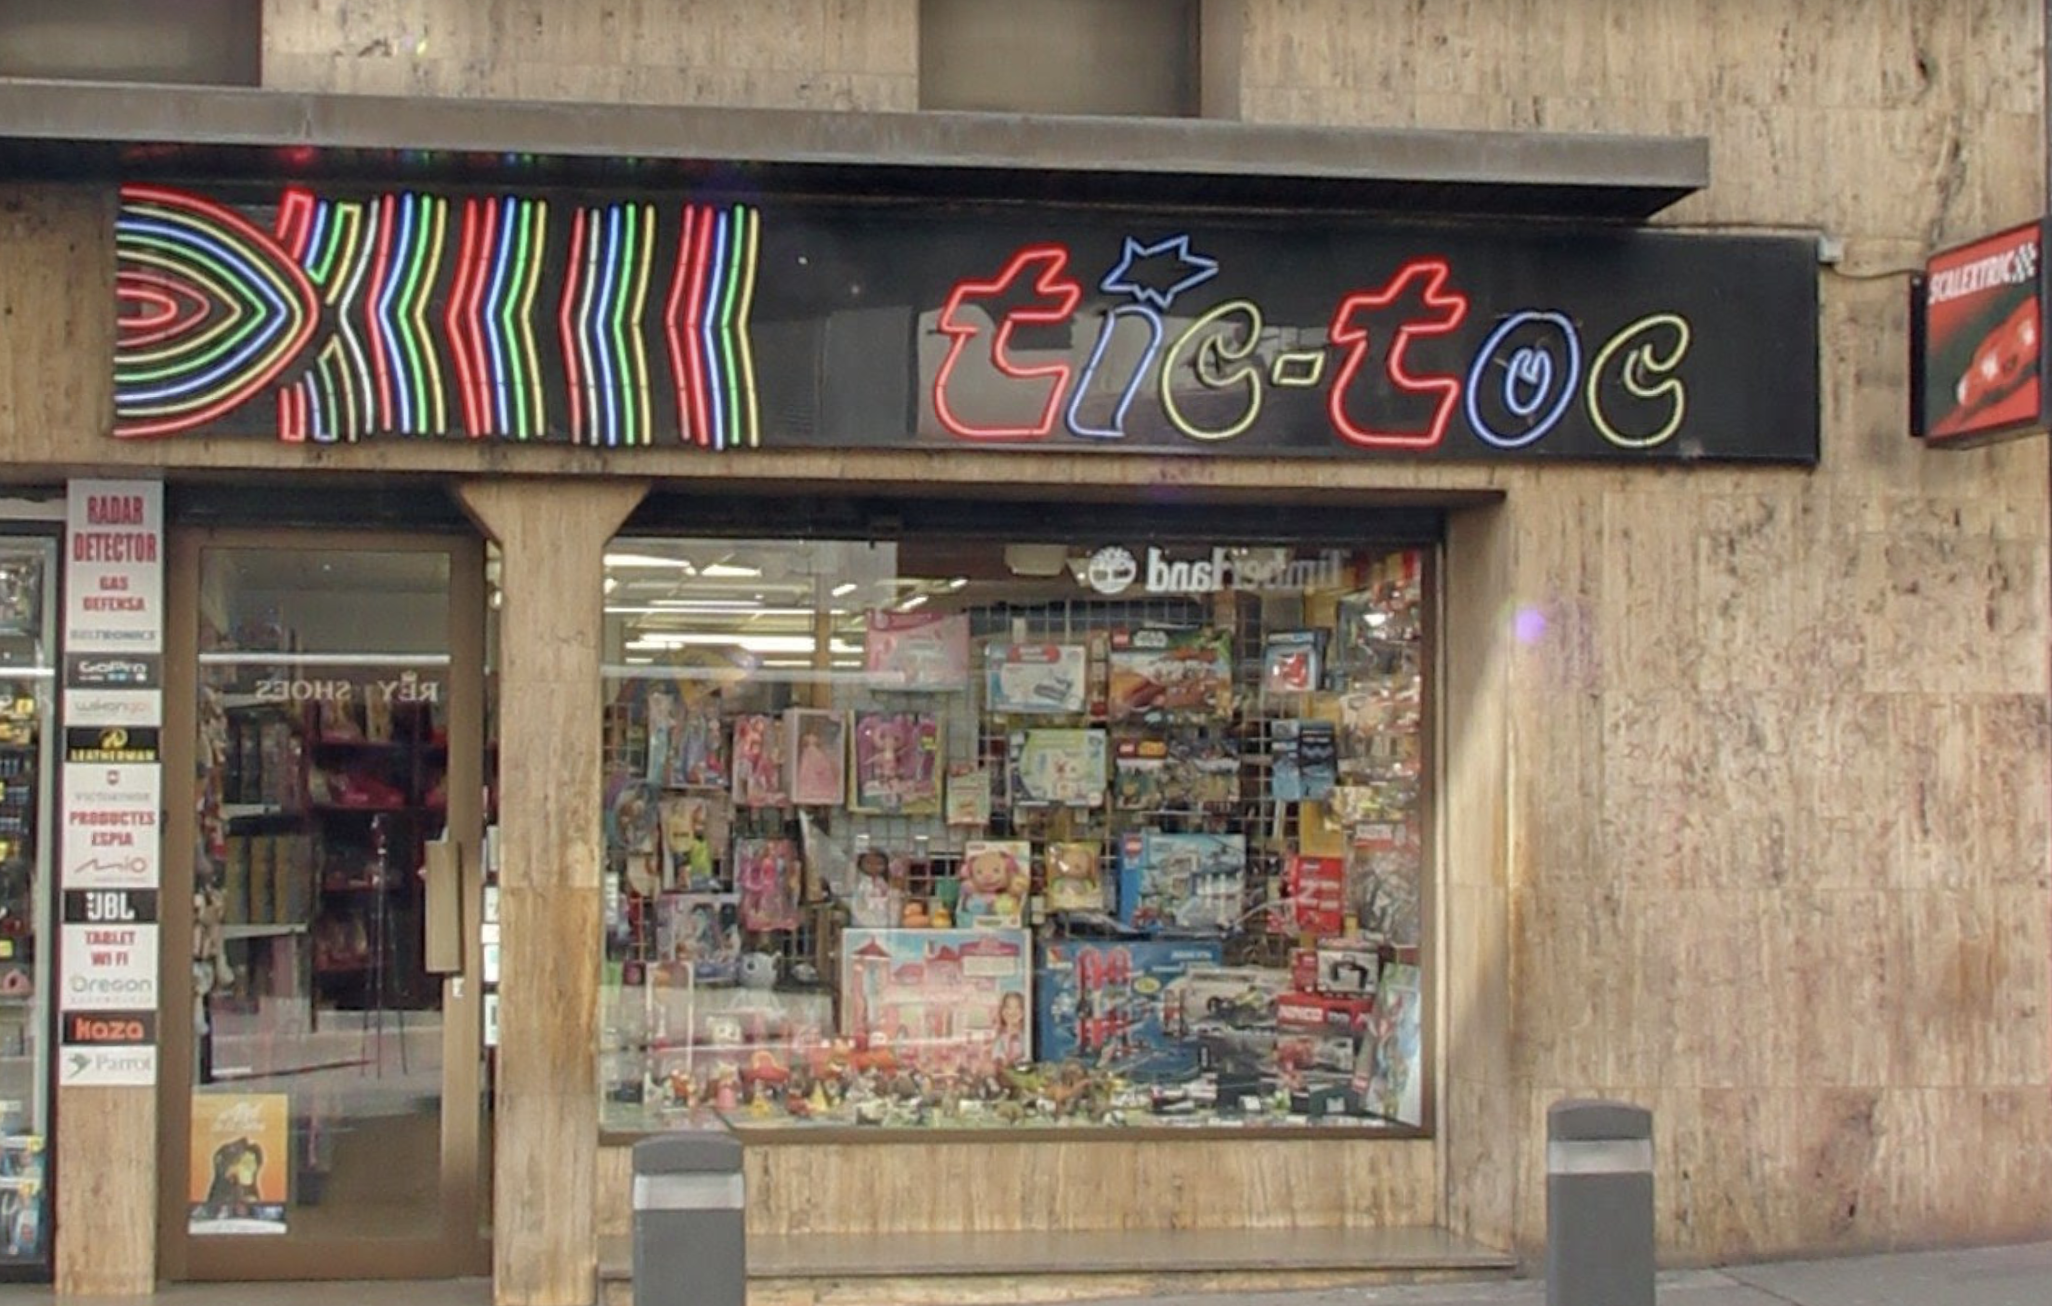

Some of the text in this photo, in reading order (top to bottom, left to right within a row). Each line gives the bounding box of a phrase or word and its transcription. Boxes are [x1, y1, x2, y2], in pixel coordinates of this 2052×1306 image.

[932, 235, 1691, 449] tic-toc
[86, 495, 144, 525] RADAR
[73, 532, 157, 562] DETECTOR
[99, 575, 129, 591] GAS
[83, 596, 145, 612] DEFENSA
[69, 811, 155, 826] PRODUCTES
[91, 832, 134, 847] ESPIA
[86, 891, 135, 921] JBL
[84, 930, 136, 946] TABLET
[70, 974, 152, 993] Oregon
